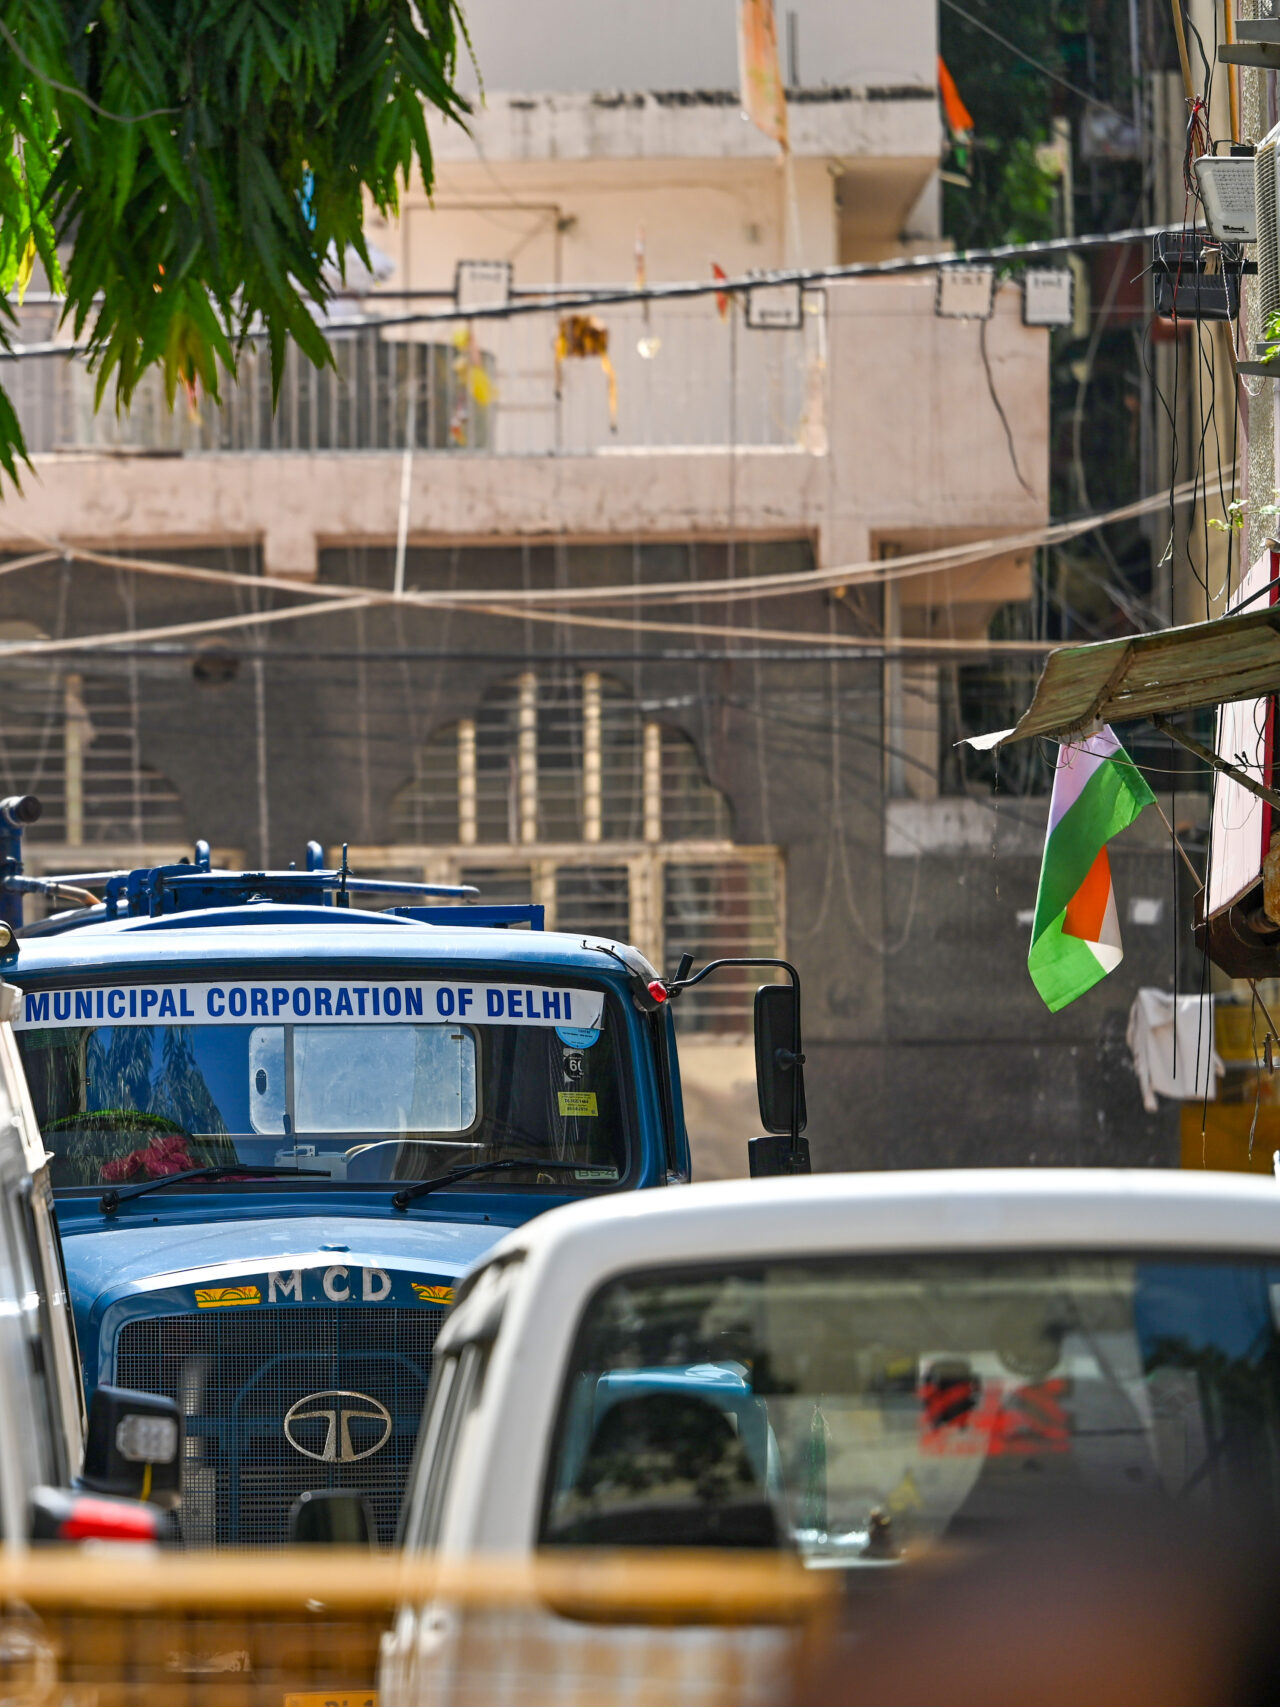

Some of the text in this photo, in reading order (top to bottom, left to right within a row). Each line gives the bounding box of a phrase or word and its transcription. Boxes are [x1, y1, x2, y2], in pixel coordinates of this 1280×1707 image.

[25, 987, 573, 1023] MUNICIPAL CORPORATION OF DELHI
